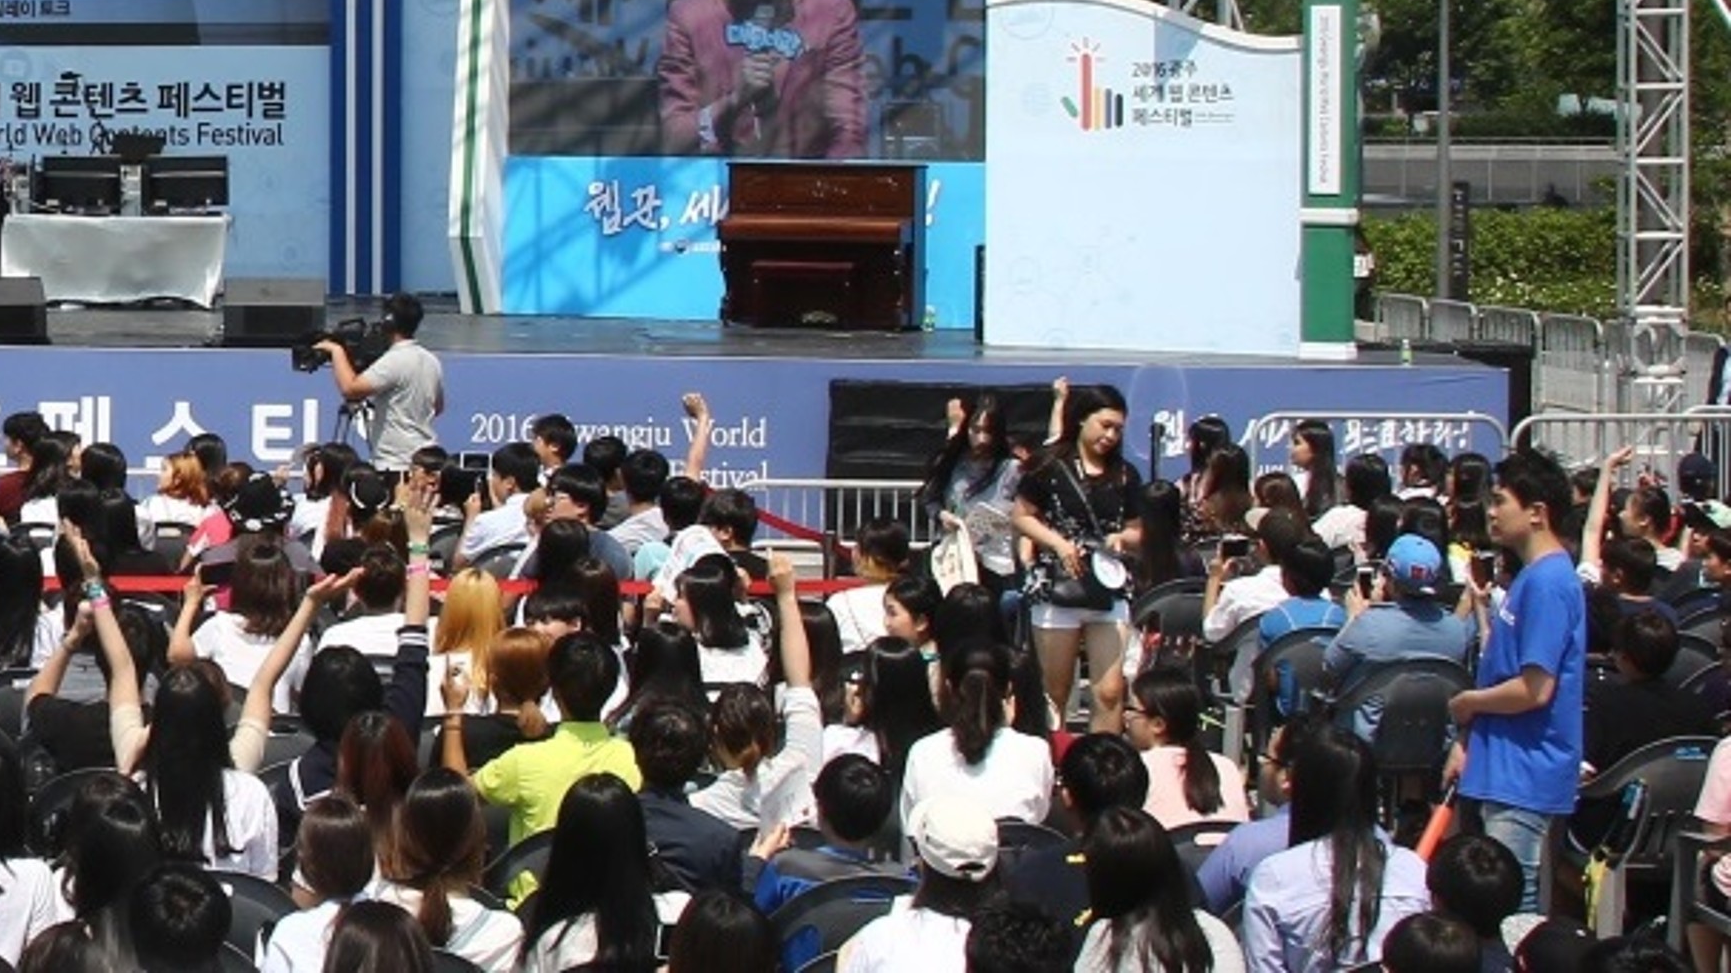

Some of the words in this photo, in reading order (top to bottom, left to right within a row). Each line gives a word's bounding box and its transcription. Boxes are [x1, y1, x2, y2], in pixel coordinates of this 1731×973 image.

[1131, 61, 1166, 78] 2016
[10, 82, 41, 118] 웹
[49, 81, 149, 118] 콘텐츠
[157, 81, 286, 119] 페스티벌
[1132, 84, 1164, 104] 세계
[1188, 83, 1235, 104] 콘텐츠
[1132, 108, 1193, 128] 페스티벌
[32, 123, 82, 147] Web
[197, 123, 284, 147] Festival
[470, 413, 534, 443] 2016
[565, 416, 671, 450] wangju
[669, 459, 768, 489] Fstival
